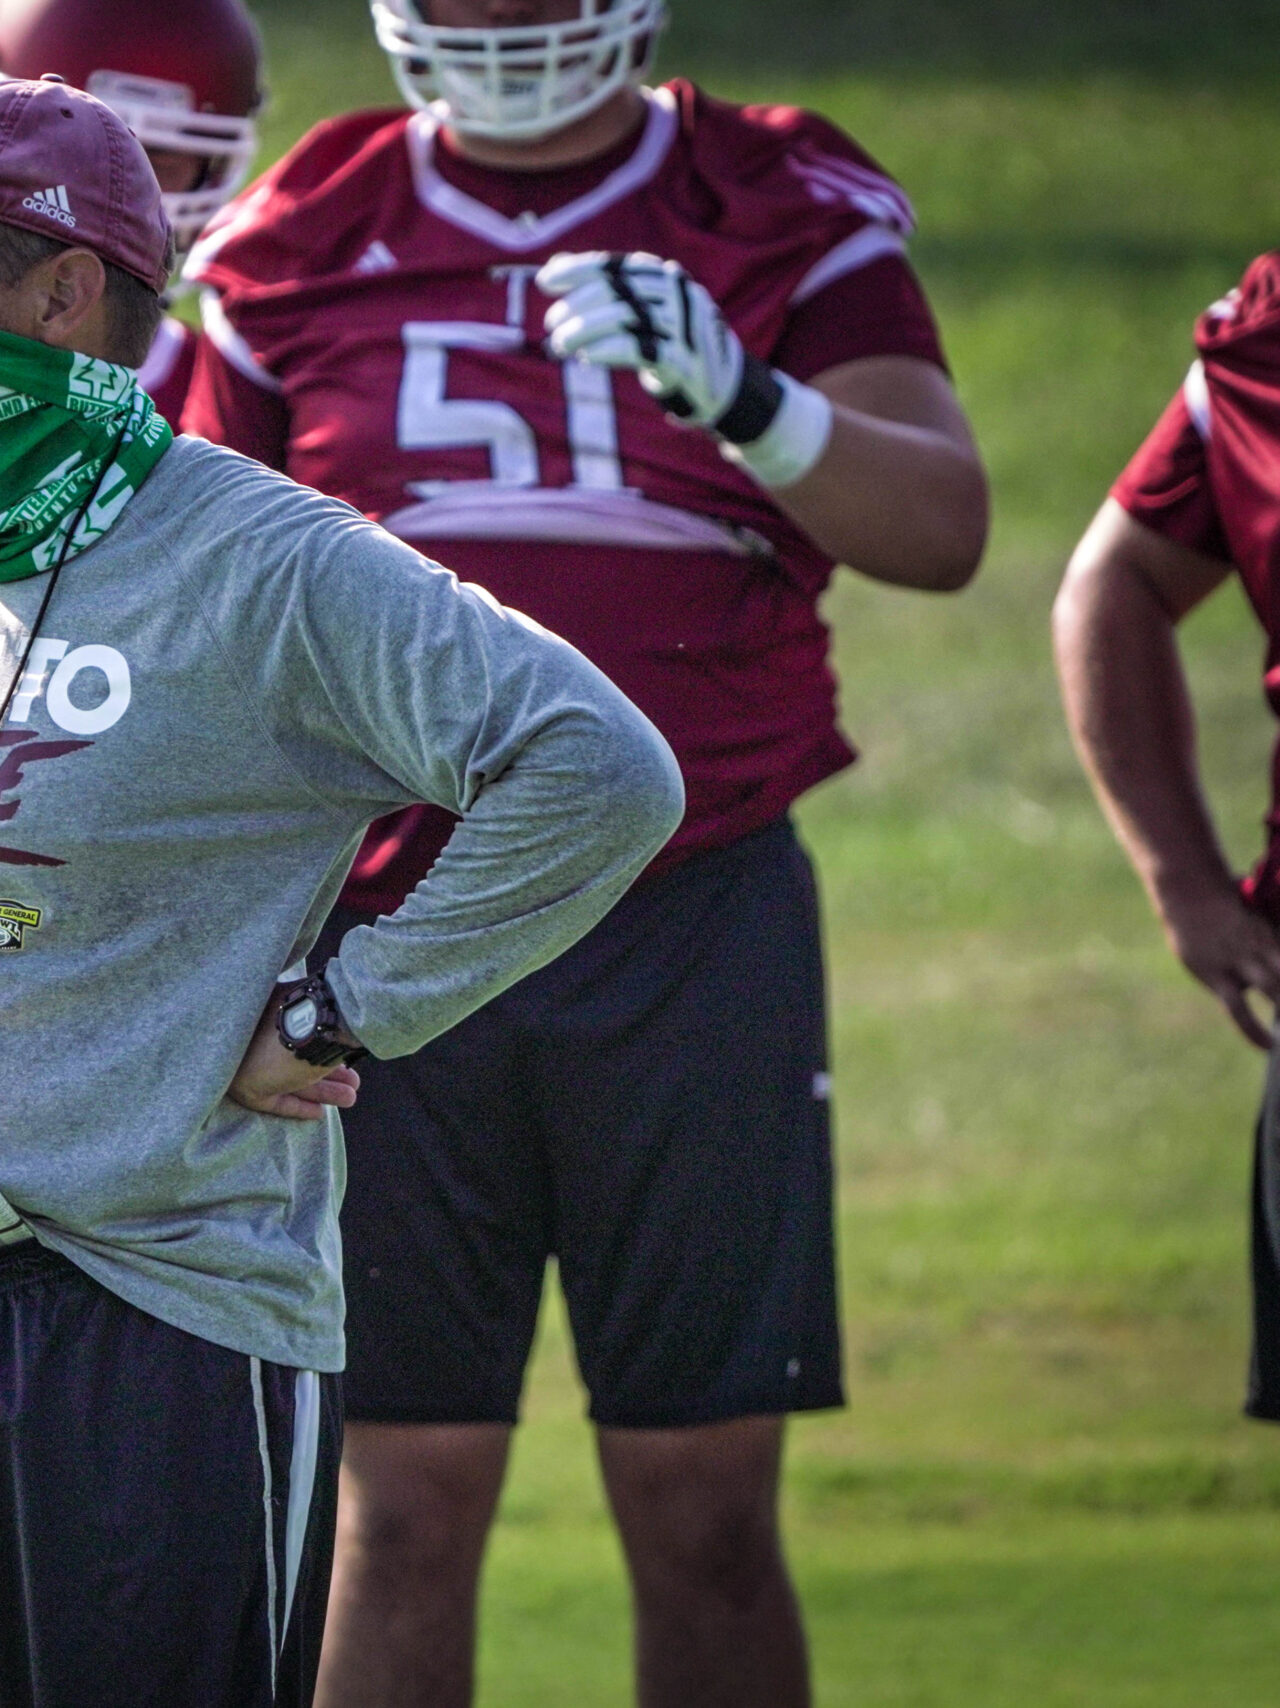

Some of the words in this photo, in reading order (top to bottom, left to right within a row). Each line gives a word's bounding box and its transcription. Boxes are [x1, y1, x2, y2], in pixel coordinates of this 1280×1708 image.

[22, 197, 76, 228] adidas
[9, 637, 131, 735] TO
[2, 908, 36, 921] GENERAL
